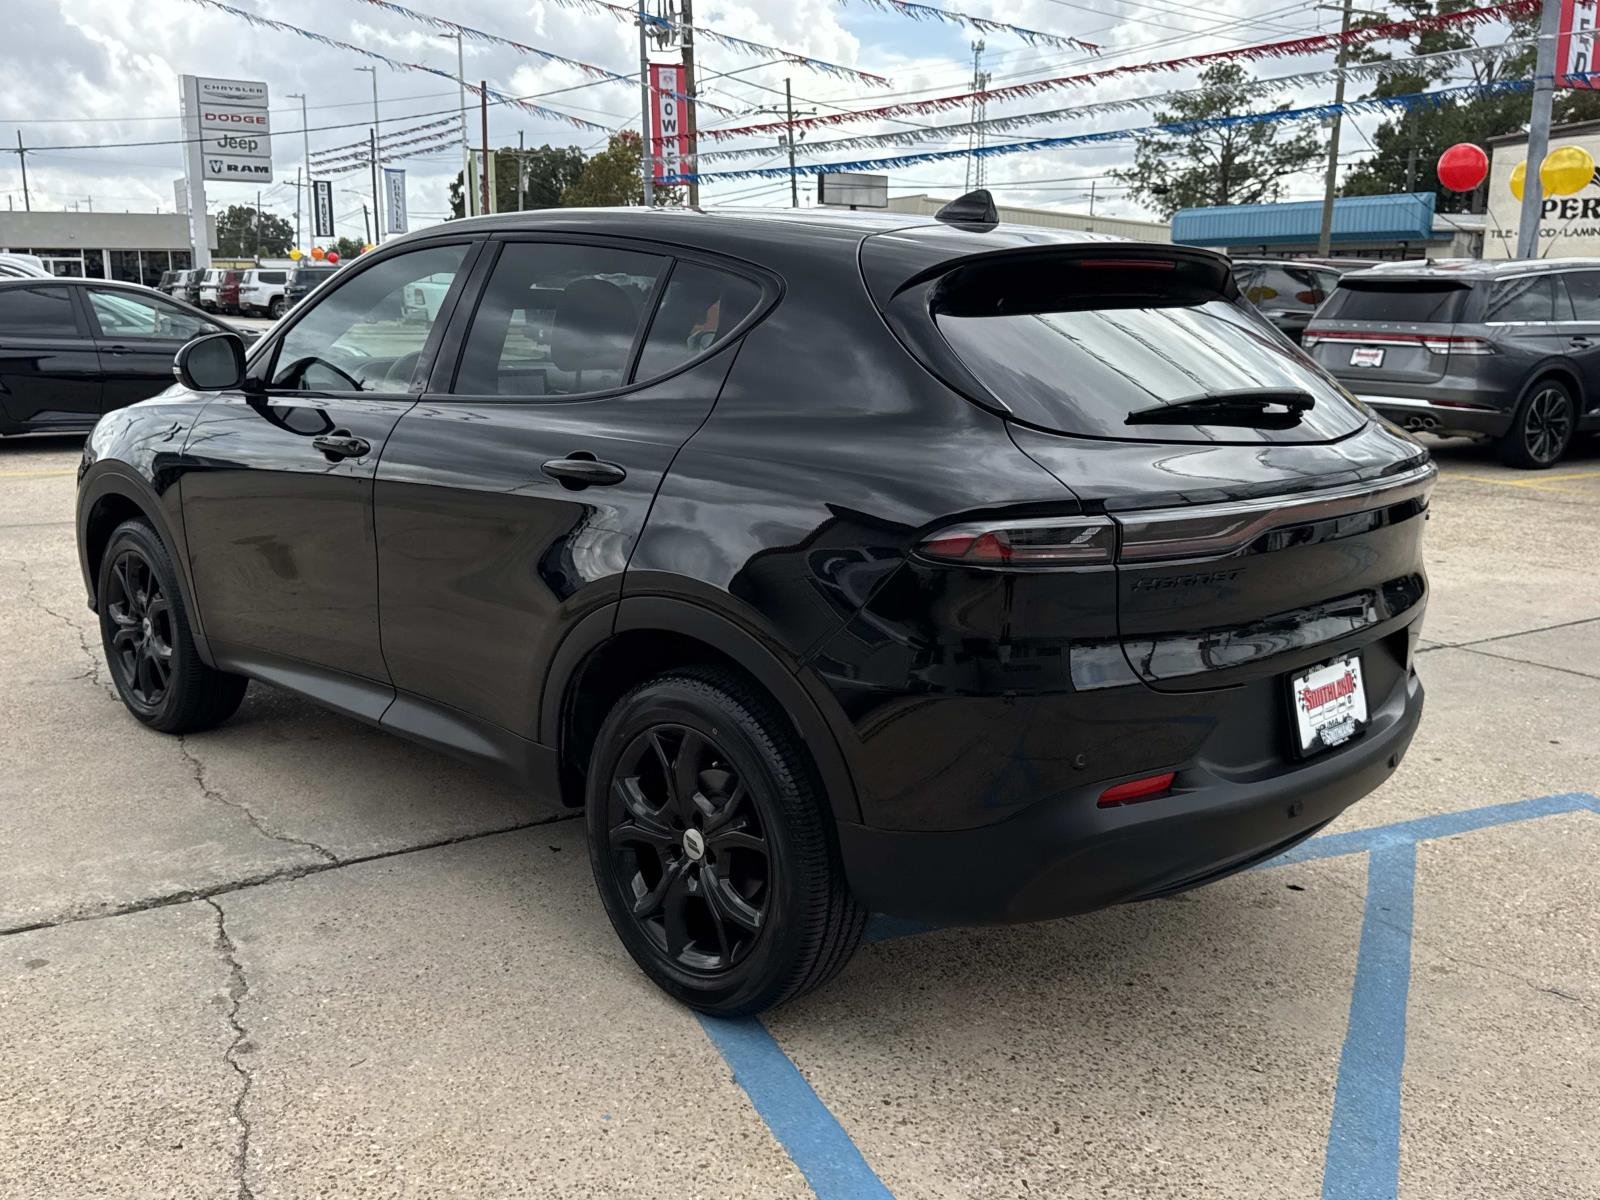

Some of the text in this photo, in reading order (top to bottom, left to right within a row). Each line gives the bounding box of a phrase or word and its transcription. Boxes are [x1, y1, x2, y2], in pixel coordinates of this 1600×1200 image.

[203, 84, 263, 94] CHRYSLER
[205, 112, 267, 124] DODGE
[217, 134, 258, 152] Jeep
[227, 164, 269, 174] RAM
[1490, 229, 1512, 239] TILE
[1303, 671, 1354, 711] SOUTHLAND
